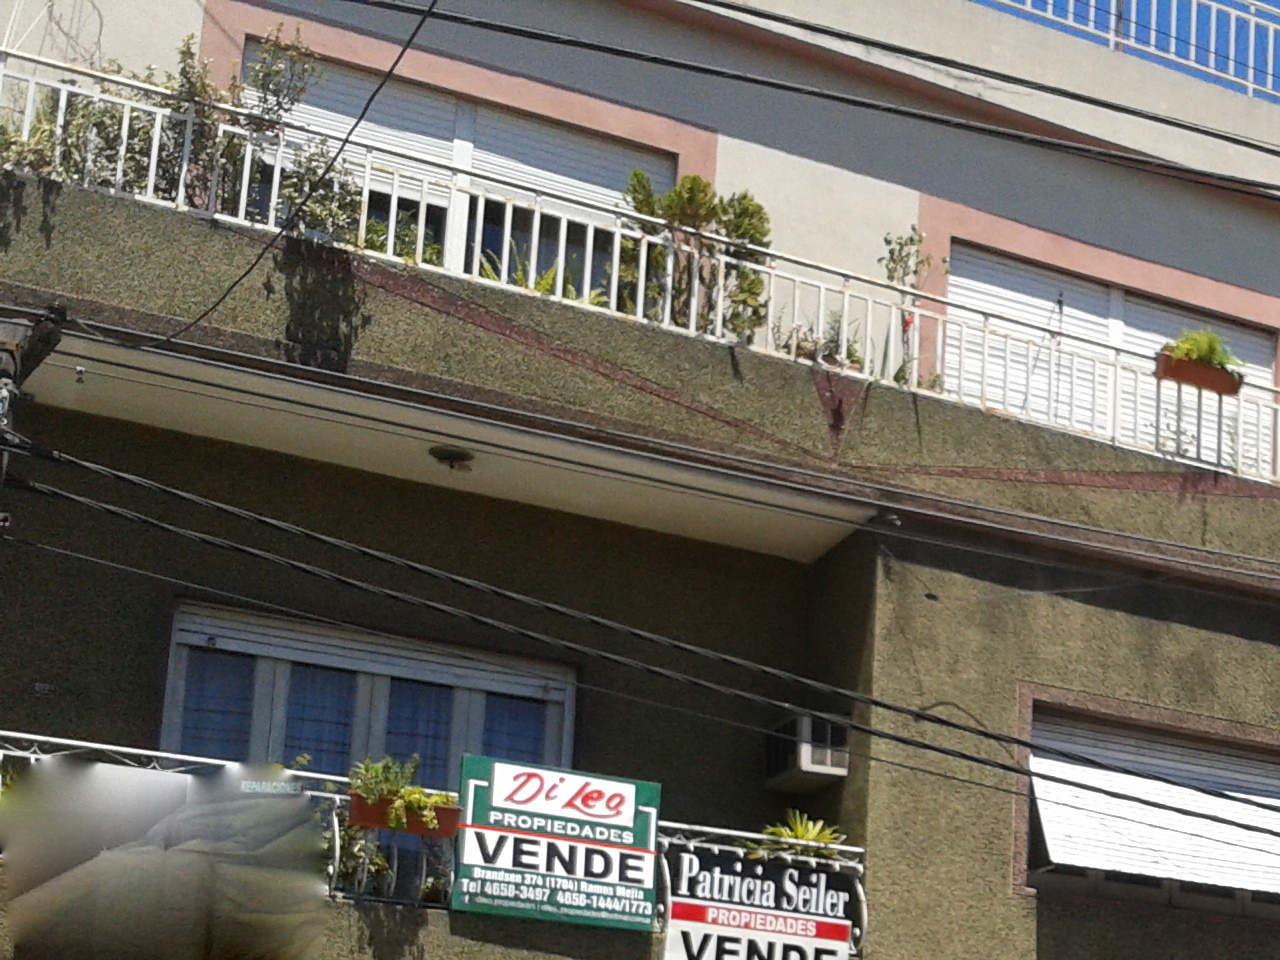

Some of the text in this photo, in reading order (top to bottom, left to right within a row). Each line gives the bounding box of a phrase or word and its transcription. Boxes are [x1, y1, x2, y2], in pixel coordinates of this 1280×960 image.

[504, 772, 627, 819] Di Leo
[488, 810, 634, 845] PROPIEDADES
[474, 830, 646, 886] VENDE
[461, 878, 482, 894] Tel
[677, 852, 850, 918] Patricia Seiler
[706, 907, 817, 937] PROPIEDADES
